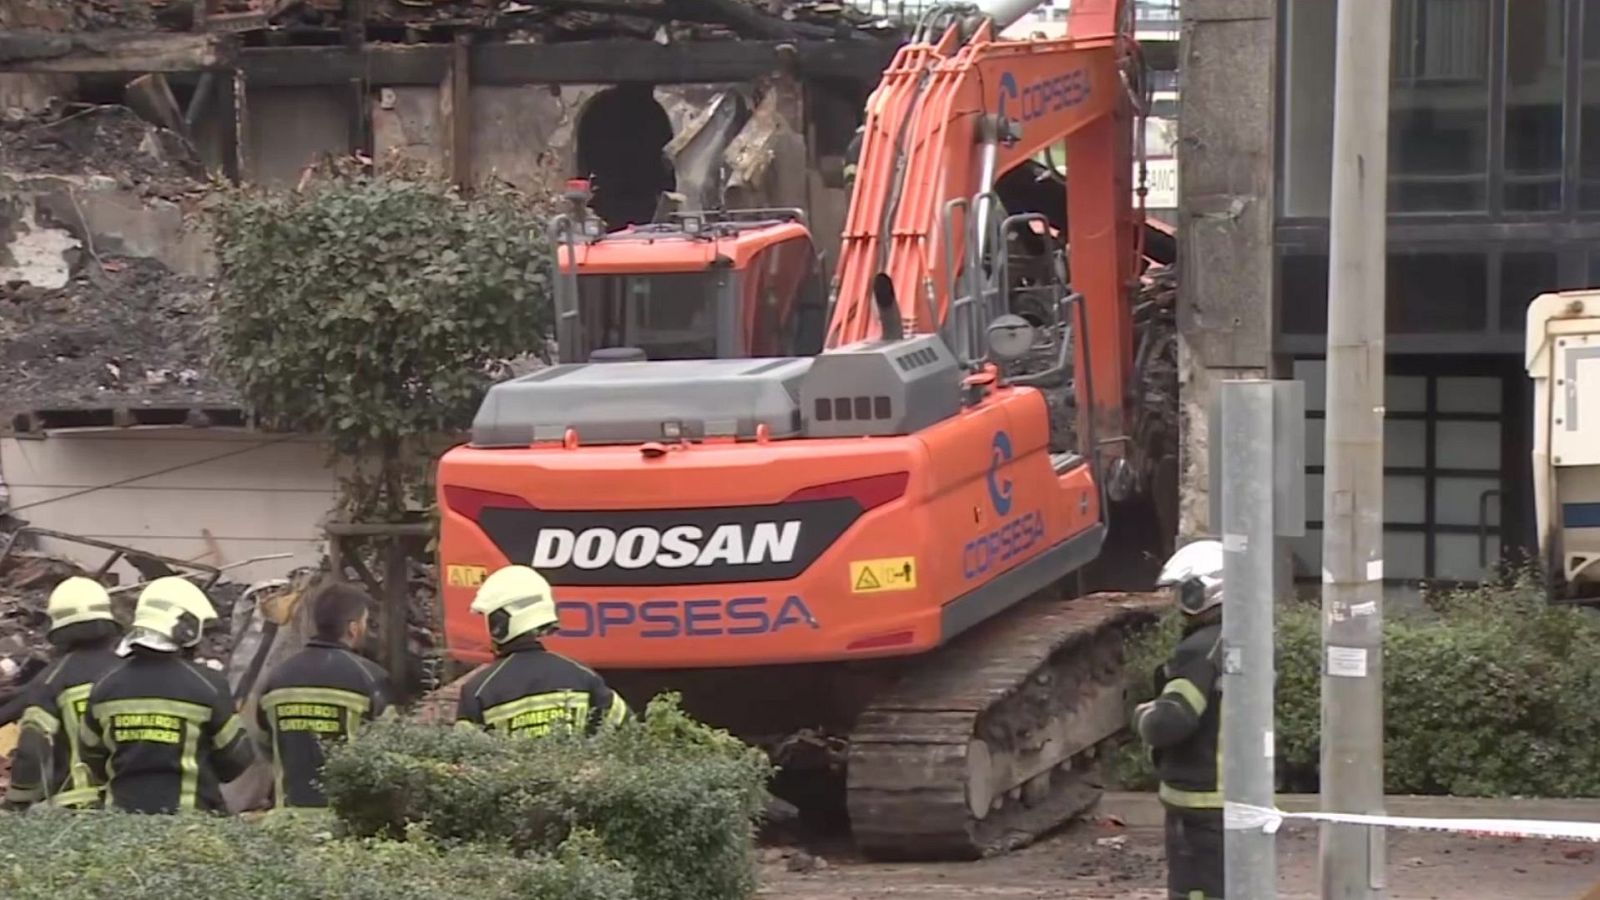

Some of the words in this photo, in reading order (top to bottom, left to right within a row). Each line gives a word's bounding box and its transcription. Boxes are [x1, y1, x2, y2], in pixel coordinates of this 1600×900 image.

[1023, 70, 1091, 121] COPSESA
[532, 521, 801, 569] DOOSAN
[963, 509, 1045, 580] COPSESA
[552, 595, 819, 638] OPSESA
